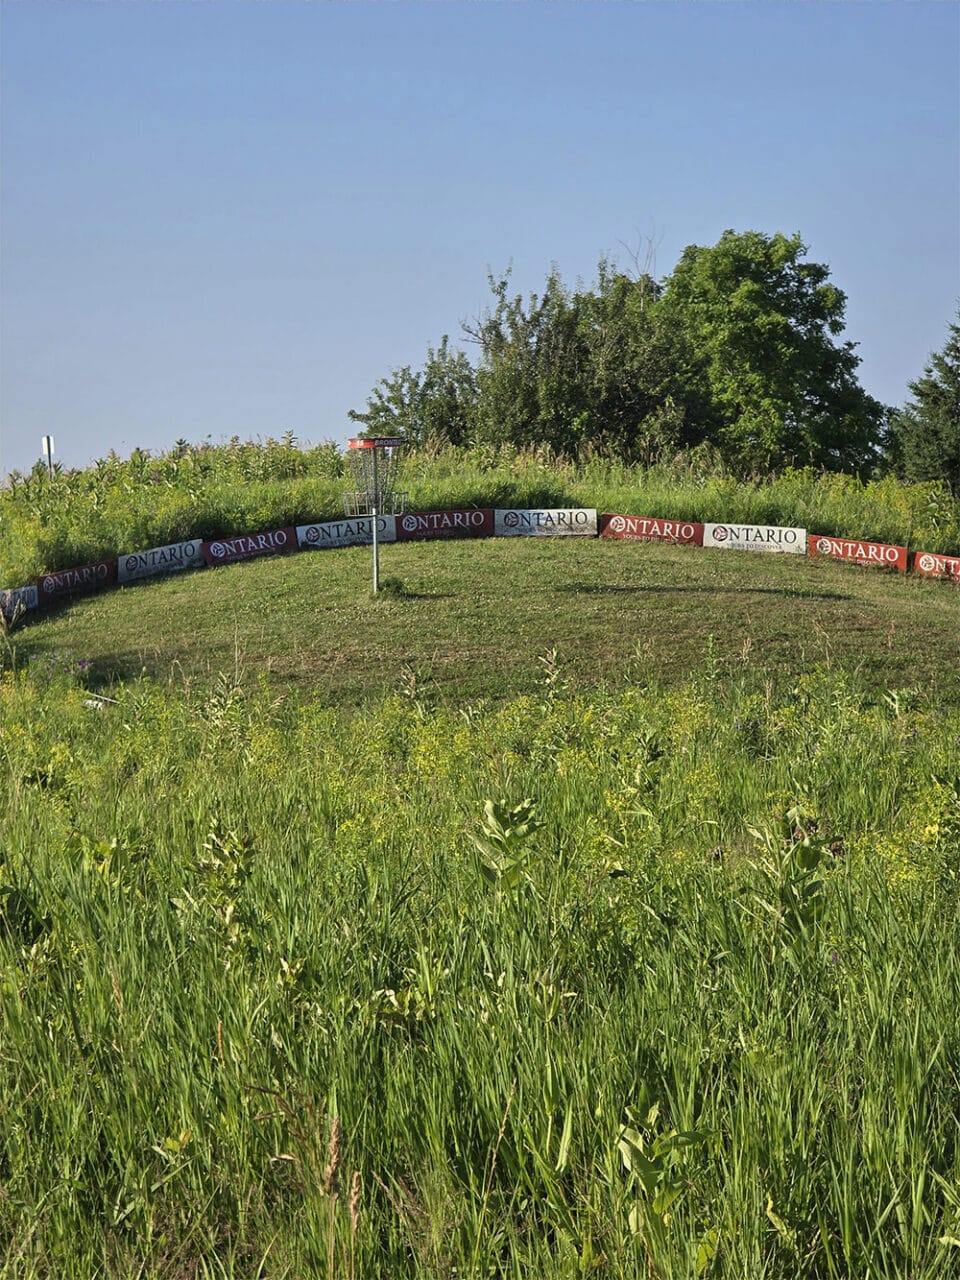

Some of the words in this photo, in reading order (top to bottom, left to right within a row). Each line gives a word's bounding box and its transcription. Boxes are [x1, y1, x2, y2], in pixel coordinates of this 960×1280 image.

[306, 518, 387, 543] ONTARIO
[402, 511, 485, 532] ONTARIO
[503, 511, 588, 530] ONTARIO
[610, 516, 695, 540] ONTARIO
[210, 530, 287, 558] ONTARIO
[713, 525, 797, 545] ONTARIO
[125, 543, 196, 572] ONTARIO
[816, 538, 899, 561] ONTARIO
[919, 554, 960, 575] ONT
[43, 563, 108, 593] ONTARIO
